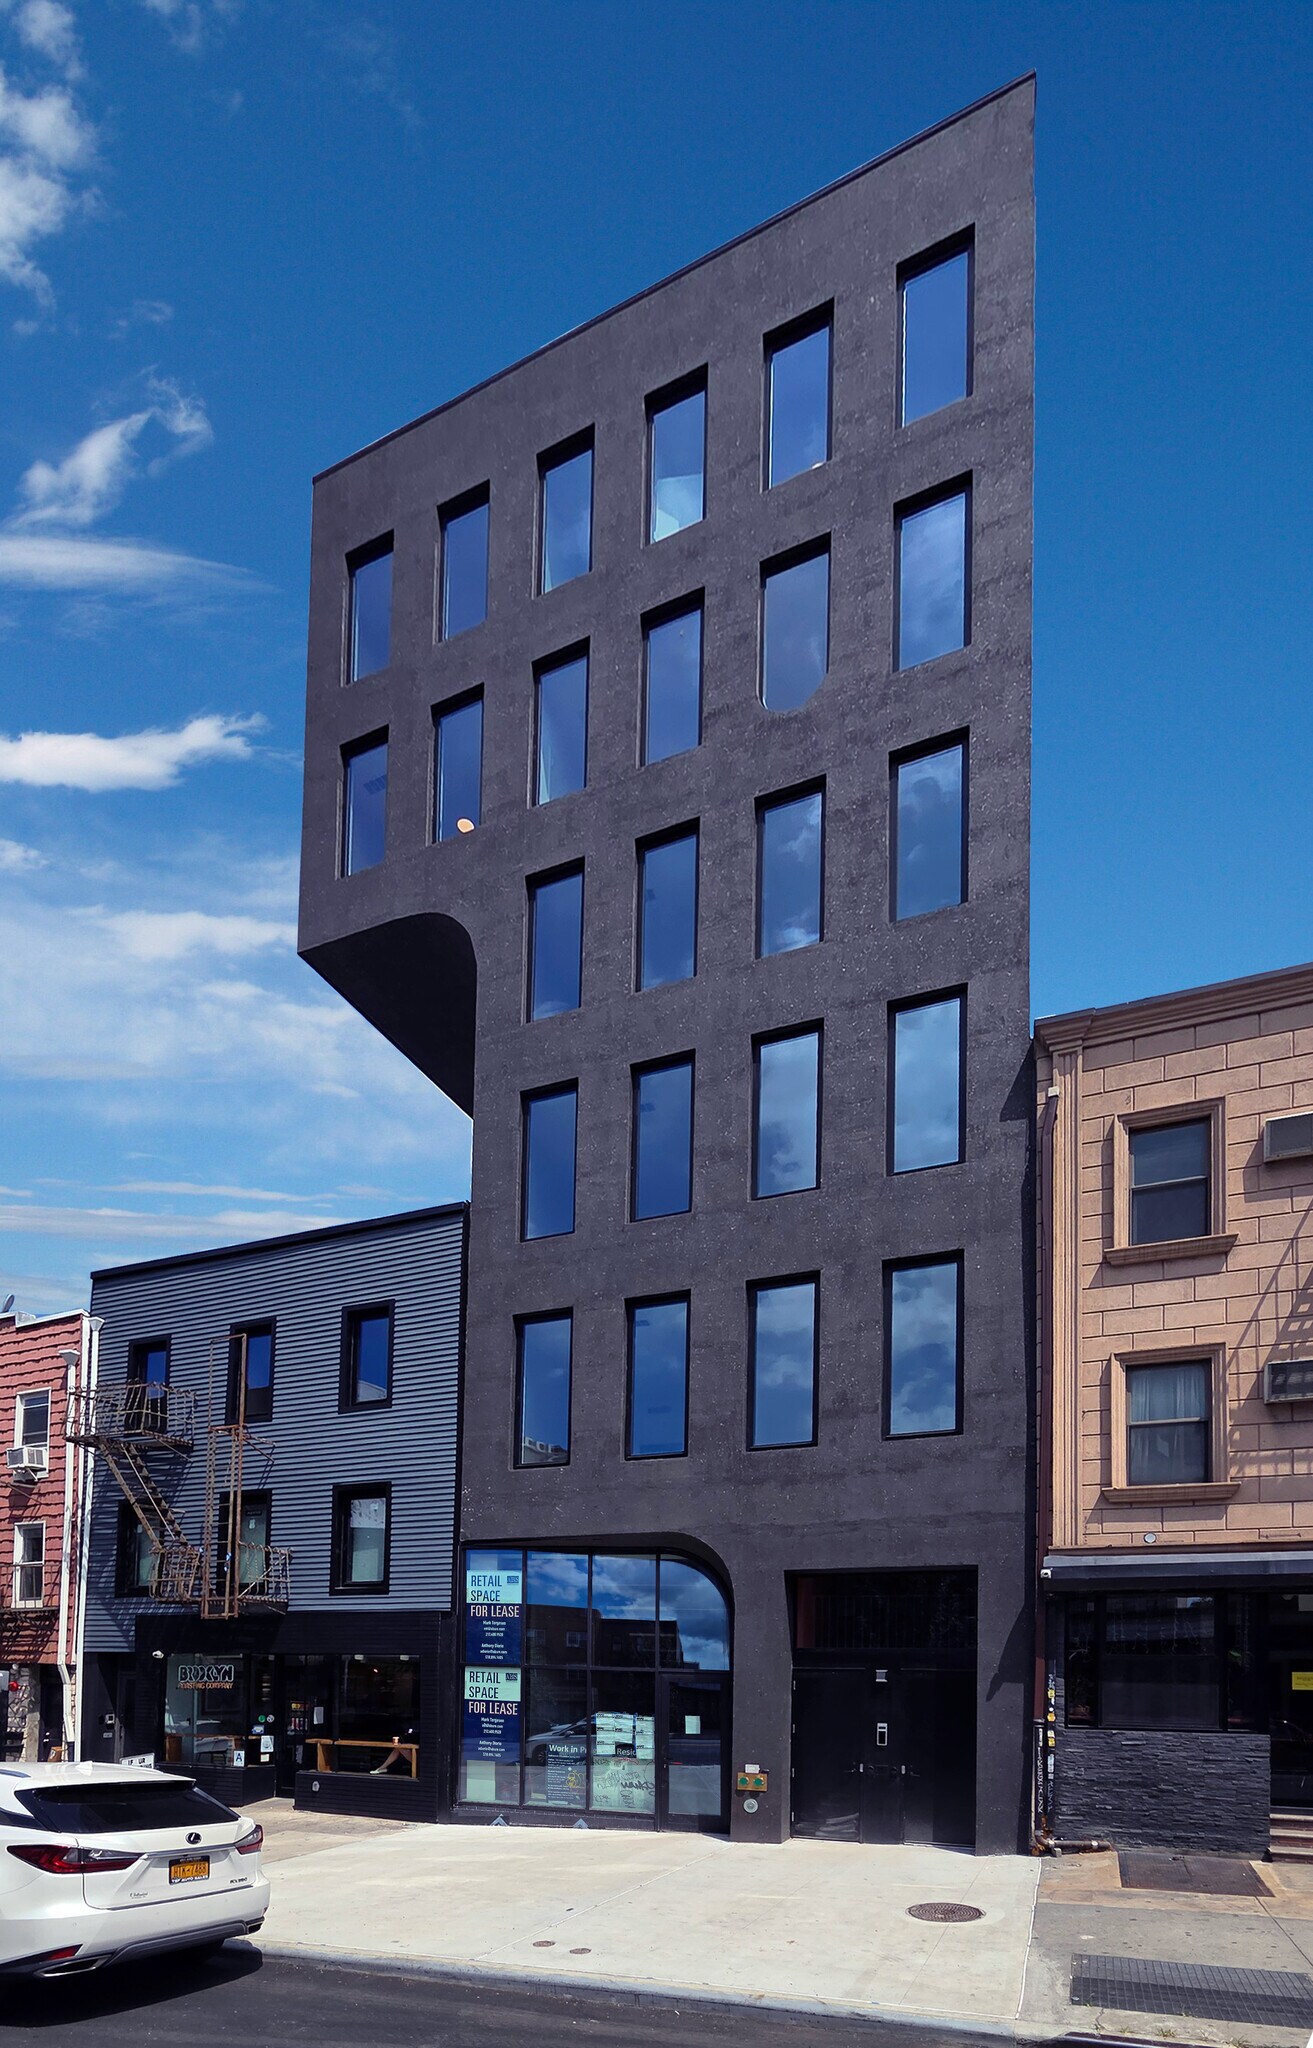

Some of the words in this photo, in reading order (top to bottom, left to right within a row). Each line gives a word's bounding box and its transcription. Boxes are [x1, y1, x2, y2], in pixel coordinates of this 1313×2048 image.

[471, 1575, 502, 1587] RETAIL
[470, 1590, 500, 1602] SPACE
[470, 1605, 488, 1617] FOR
[491, 1605, 520, 1618] LEASE
[178, 1664, 234, 1682] BROOKLYN
[469, 1671, 501, 1684] RETAIL
[469, 1686, 498, 1699] SPACE
[468, 1701, 486, 1714] FOR
[490, 1702, 518, 1715] LEASE
[549, 1744, 569, 1753] Work
[236, 1752, 243, 1762] A
